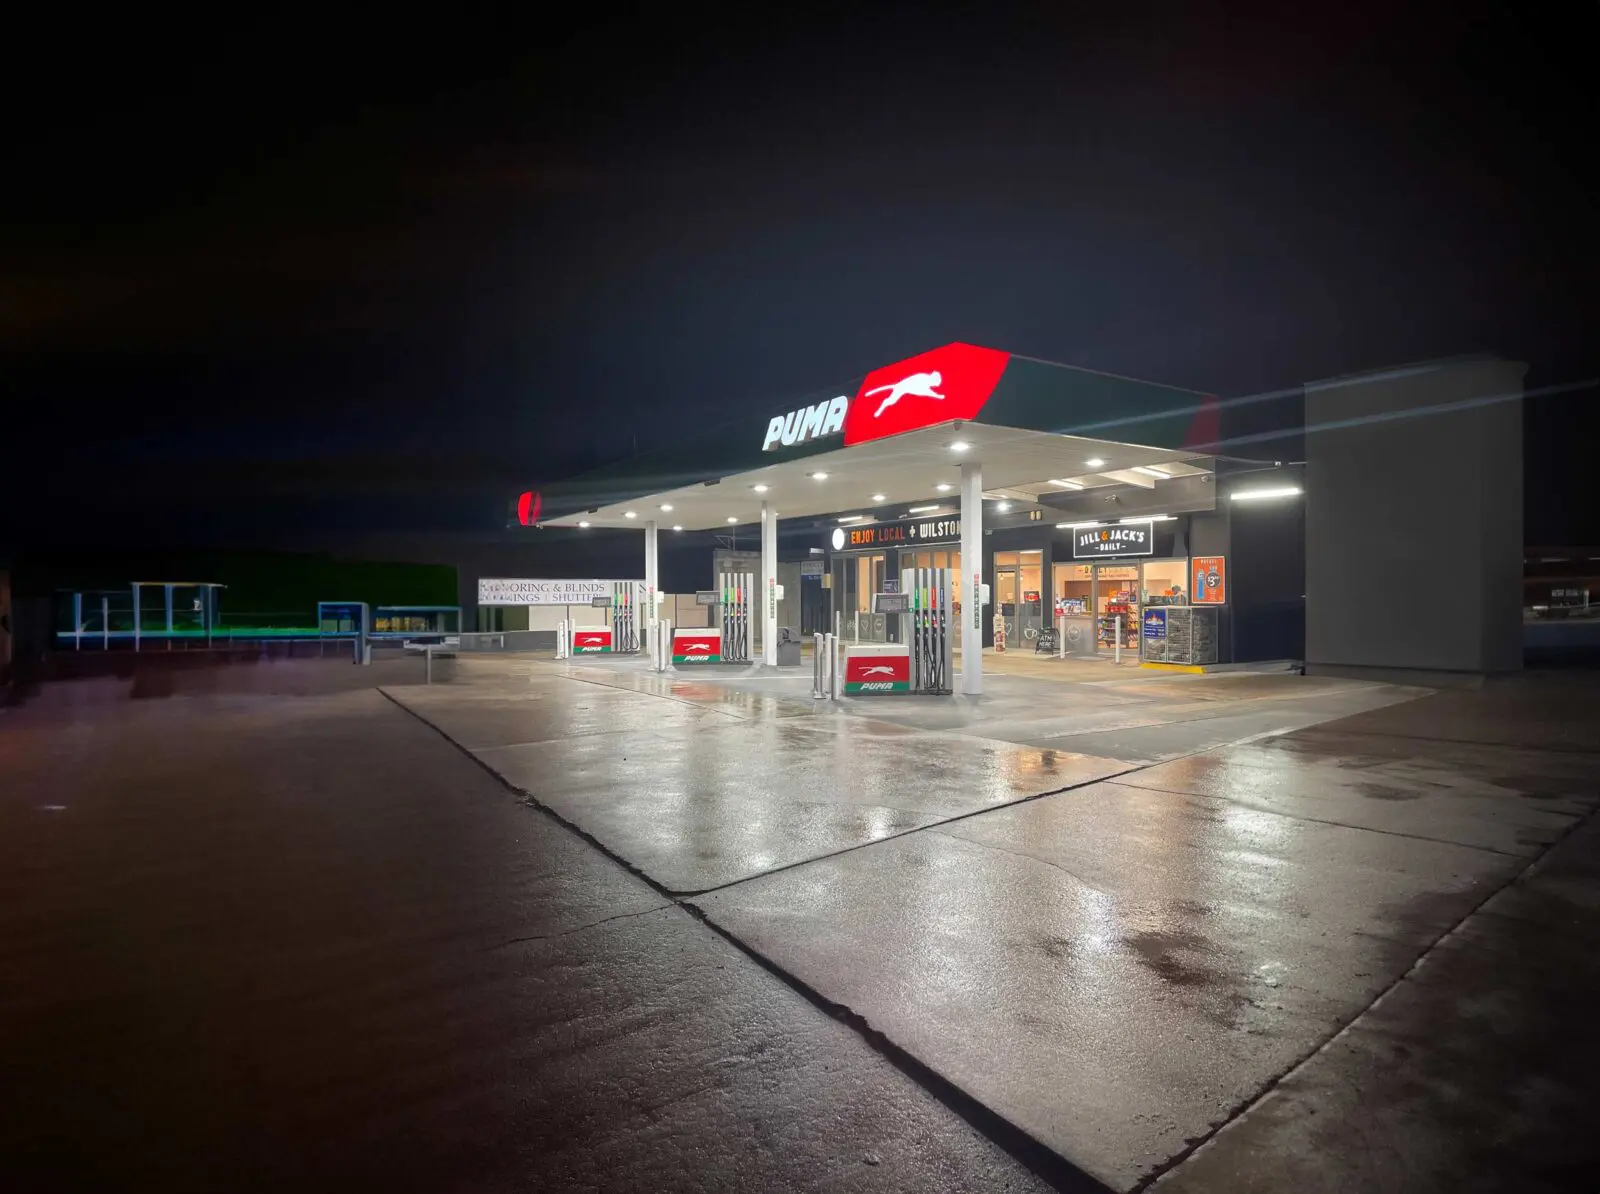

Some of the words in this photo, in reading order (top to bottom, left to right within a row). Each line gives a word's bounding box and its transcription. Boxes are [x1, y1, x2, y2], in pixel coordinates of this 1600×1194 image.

[762, 396, 848, 451] PUMA
[851, 528, 875, 545] ENJOY
[878, 526, 905, 542] LOCAL
[1079, 531, 1100, 546] JILL
[1100, 530, 1110, 542] &
[1110, 529, 1145, 543] JACK'S
[1099, 542, 1121, 551] DAILY
[552, 583, 561, 592] &
[565, 583, 605, 593] BLINDS
[860, 682, 894, 691] PUMA
